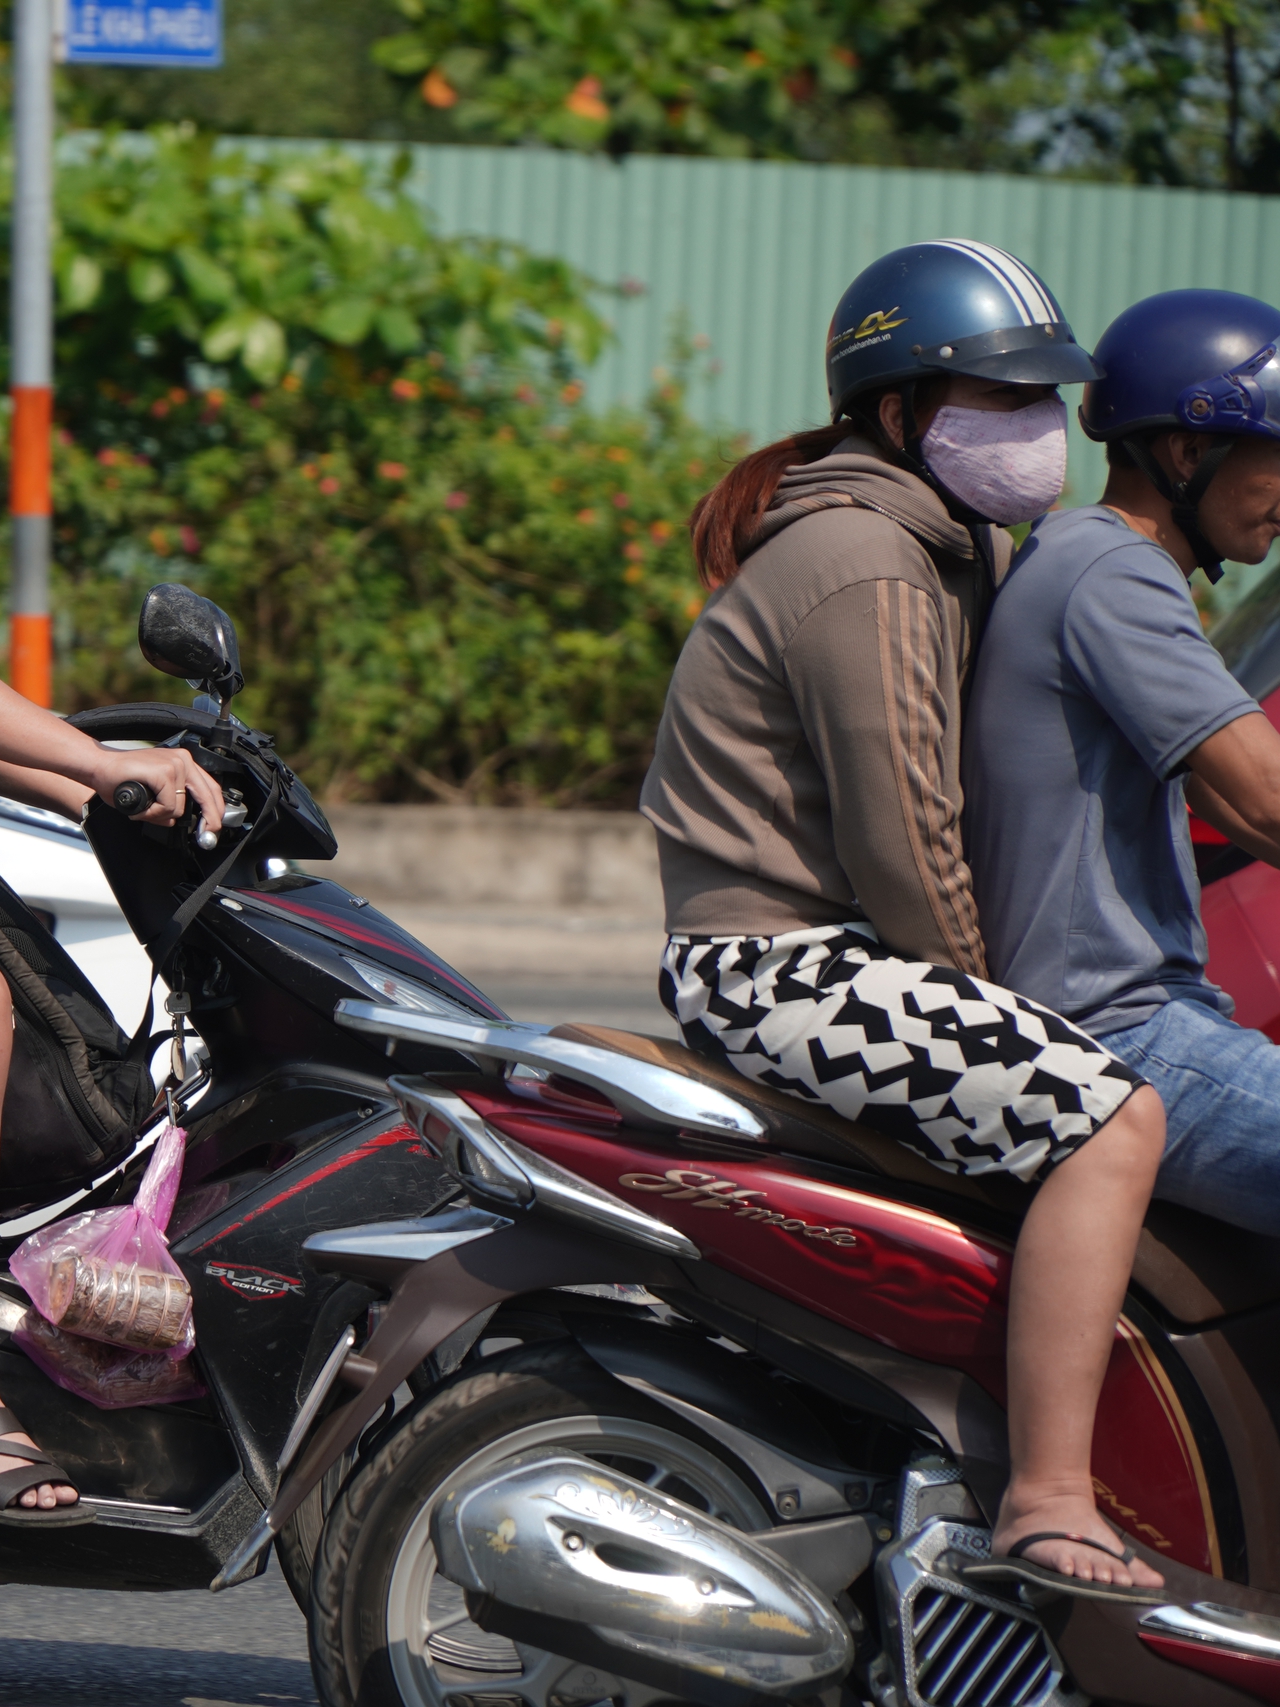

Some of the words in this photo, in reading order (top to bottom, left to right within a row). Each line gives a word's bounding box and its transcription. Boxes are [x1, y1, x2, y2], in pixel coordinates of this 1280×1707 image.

[618, 1169, 768, 1209] SH
[734, 1206, 857, 1247] mode
[205, 1265, 306, 1298] BLACK
[231, 1281, 275, 1295] EDITION
[1091, 1475, 1173, 1548] GM-FI
